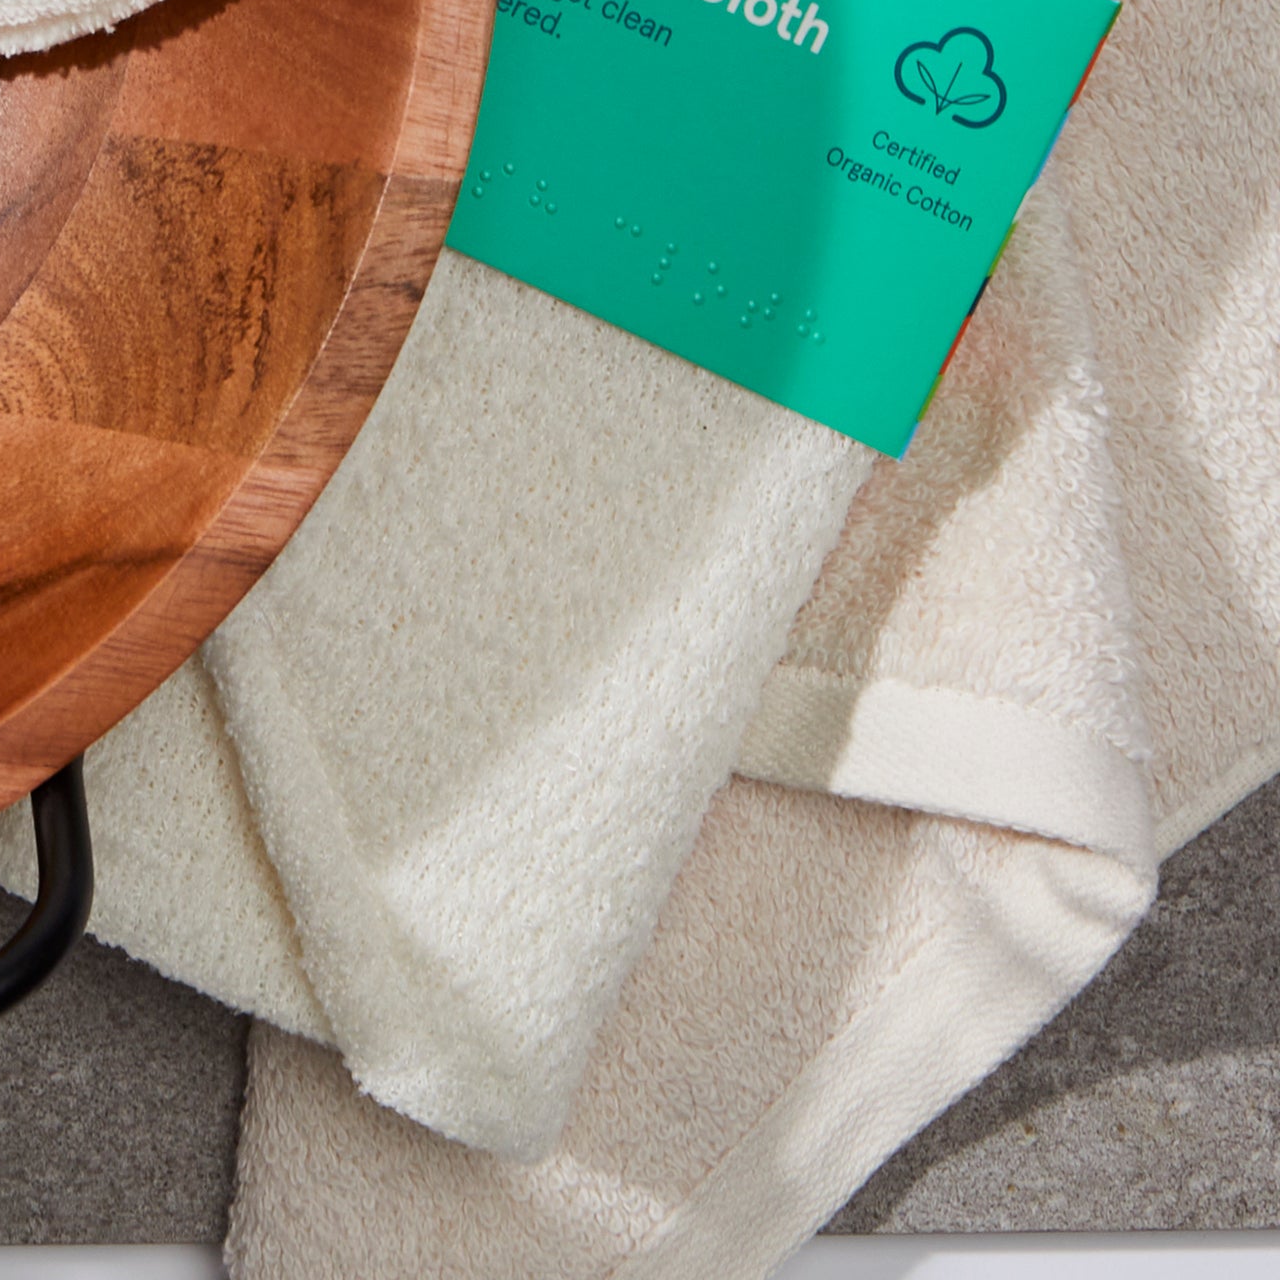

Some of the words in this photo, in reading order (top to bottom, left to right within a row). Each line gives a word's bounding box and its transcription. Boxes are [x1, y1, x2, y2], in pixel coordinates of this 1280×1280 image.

[601, 0, 673, 47] clean
[871, 130, 961, 187] Certified
[826, 146, 902, 197] Organic
[906, 185, 973, 232] Cotton
